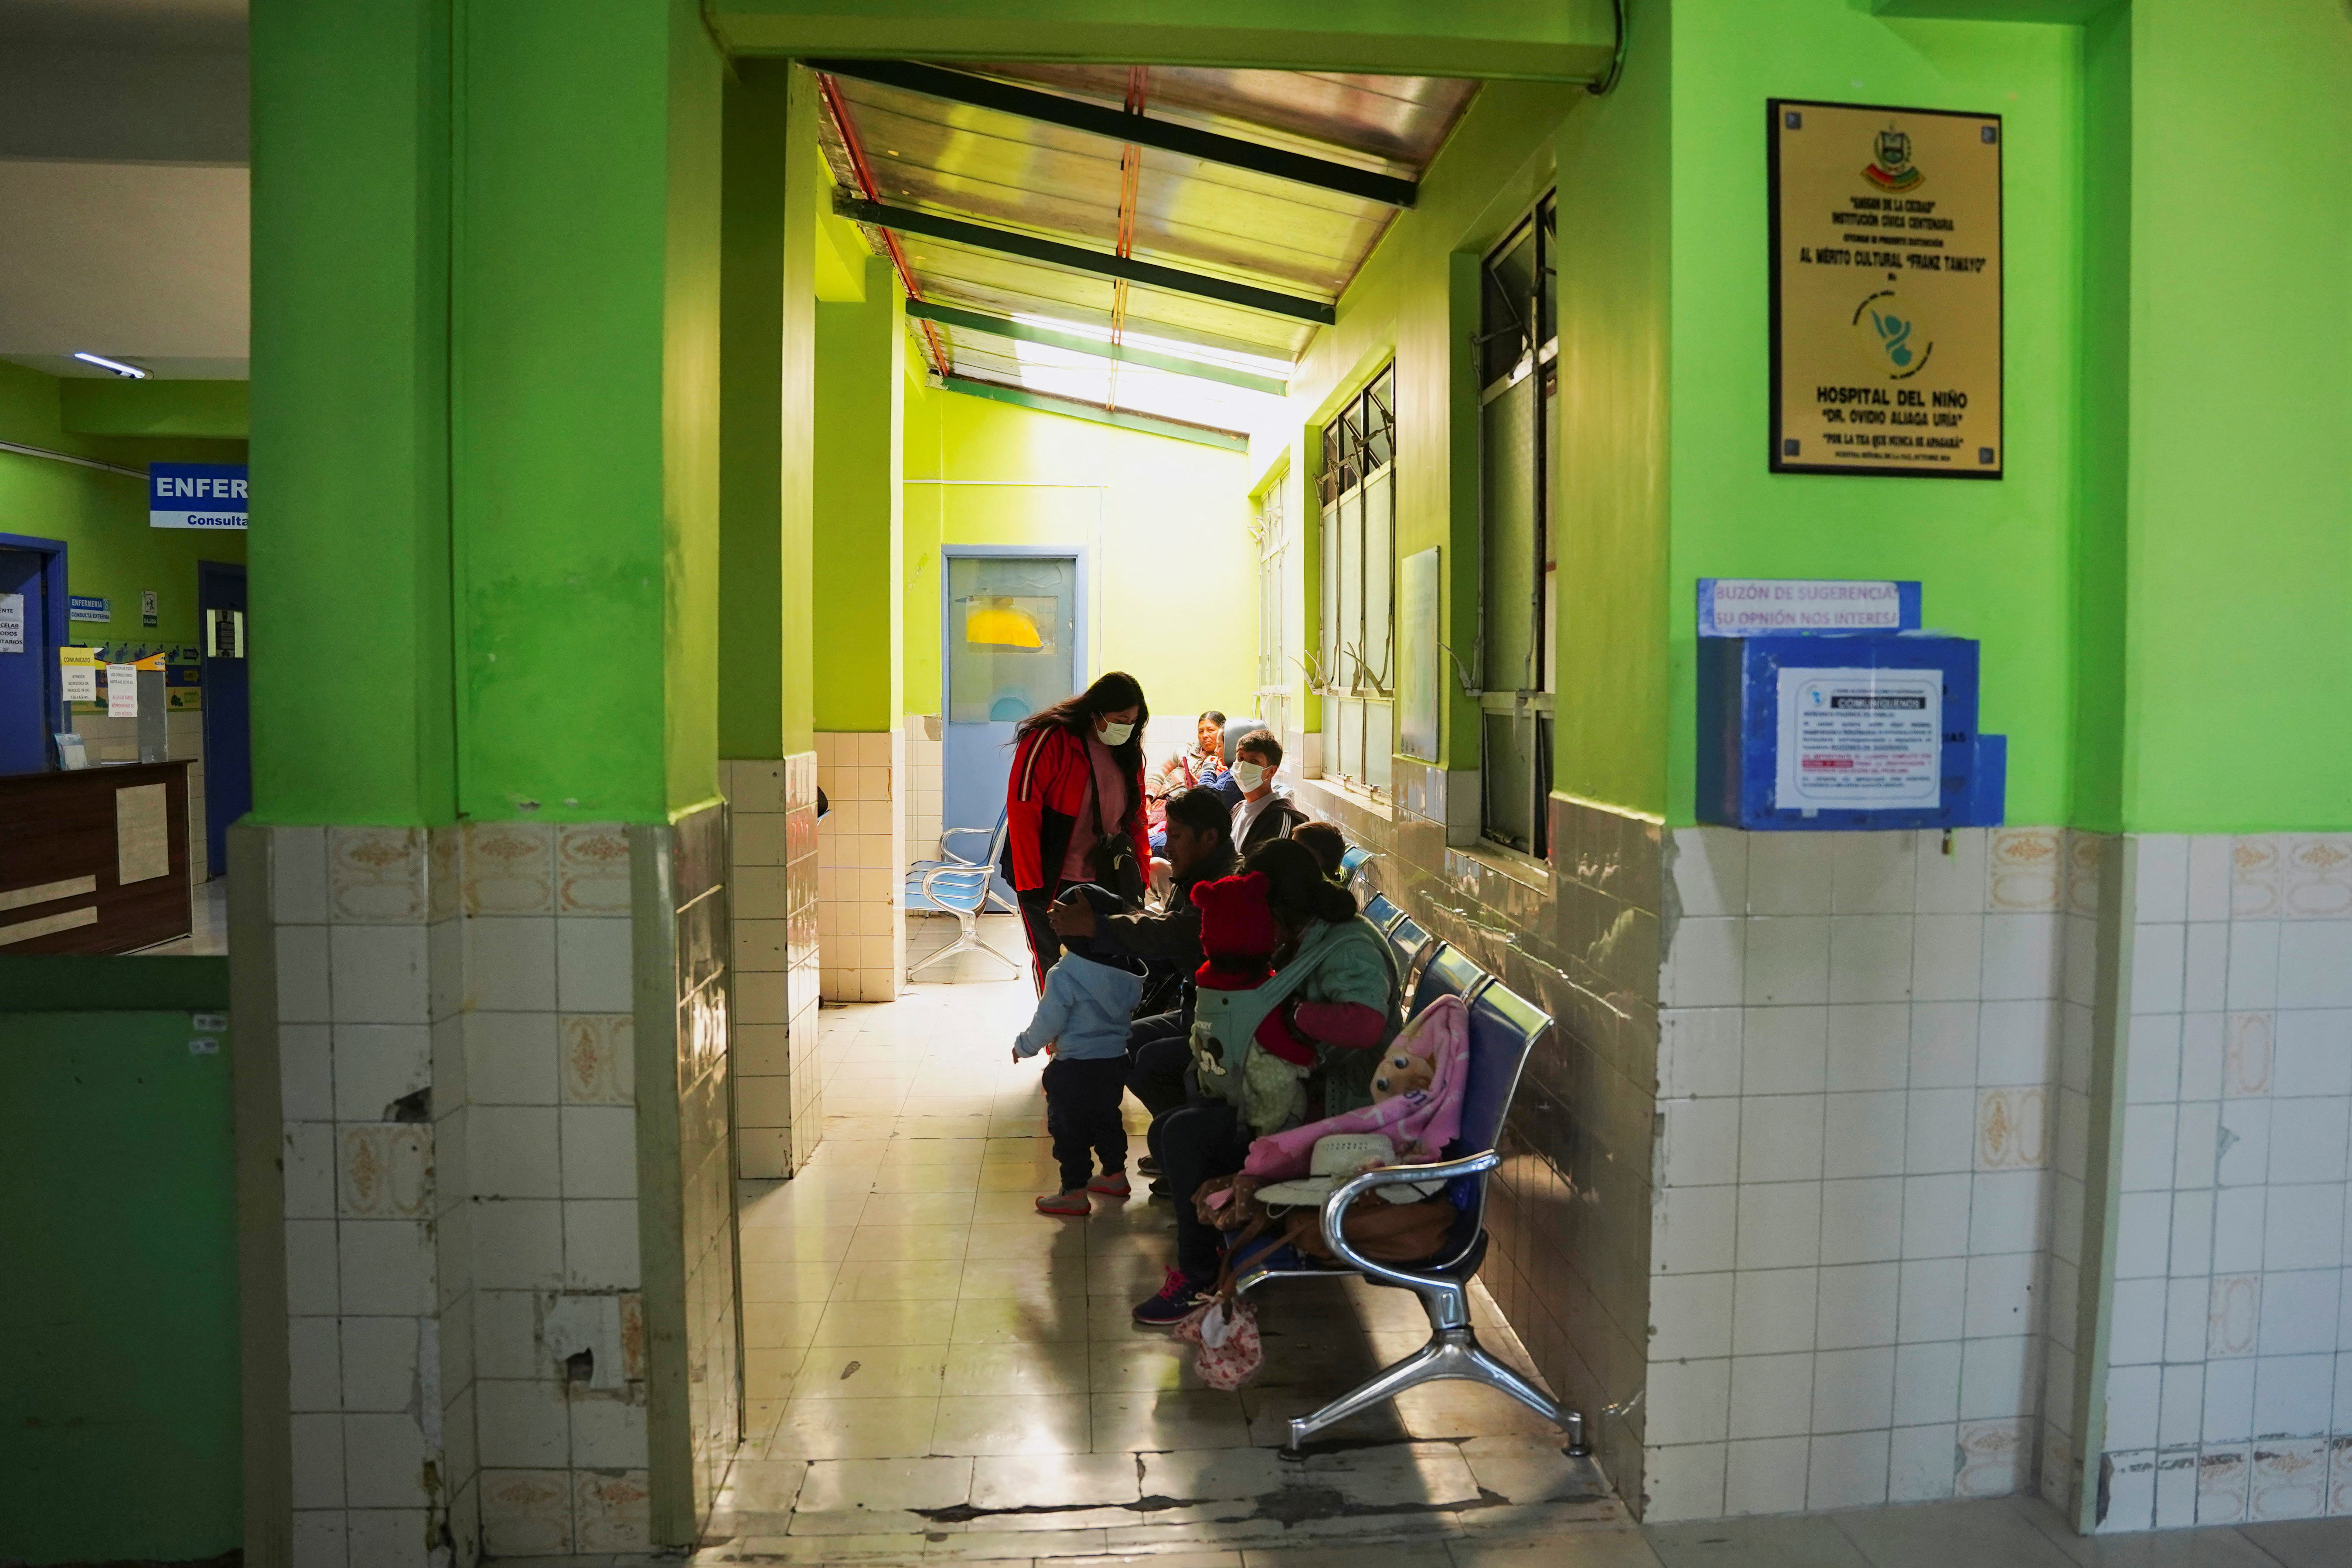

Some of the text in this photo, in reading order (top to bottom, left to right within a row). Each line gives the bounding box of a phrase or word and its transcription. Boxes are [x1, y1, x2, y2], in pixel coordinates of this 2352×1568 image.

[1800, 247, 1812, 263] AL
[1854, 250, 1903, 269] CULTURAL
[1817, 386, 1968, 409] HOSPITAL DEL NIÑO
[1849, 409, 1886, 424] OVIDIO
[1890, 411, 1929, 426] ALIAGA
[1844, 433, 1853, 445] LA
[157, 477, 249, 498] ENFER
[187, 515, 248, 526] Consulta
[1716, 583, 1769, 600] BUZÓN
[1775, 586, 1794, 600] DE
[72, 599, 102, 608] ENFERMERIA
[1717, 612, 1734, 625] SU
[1801, 612, 1830, 624] NOS
